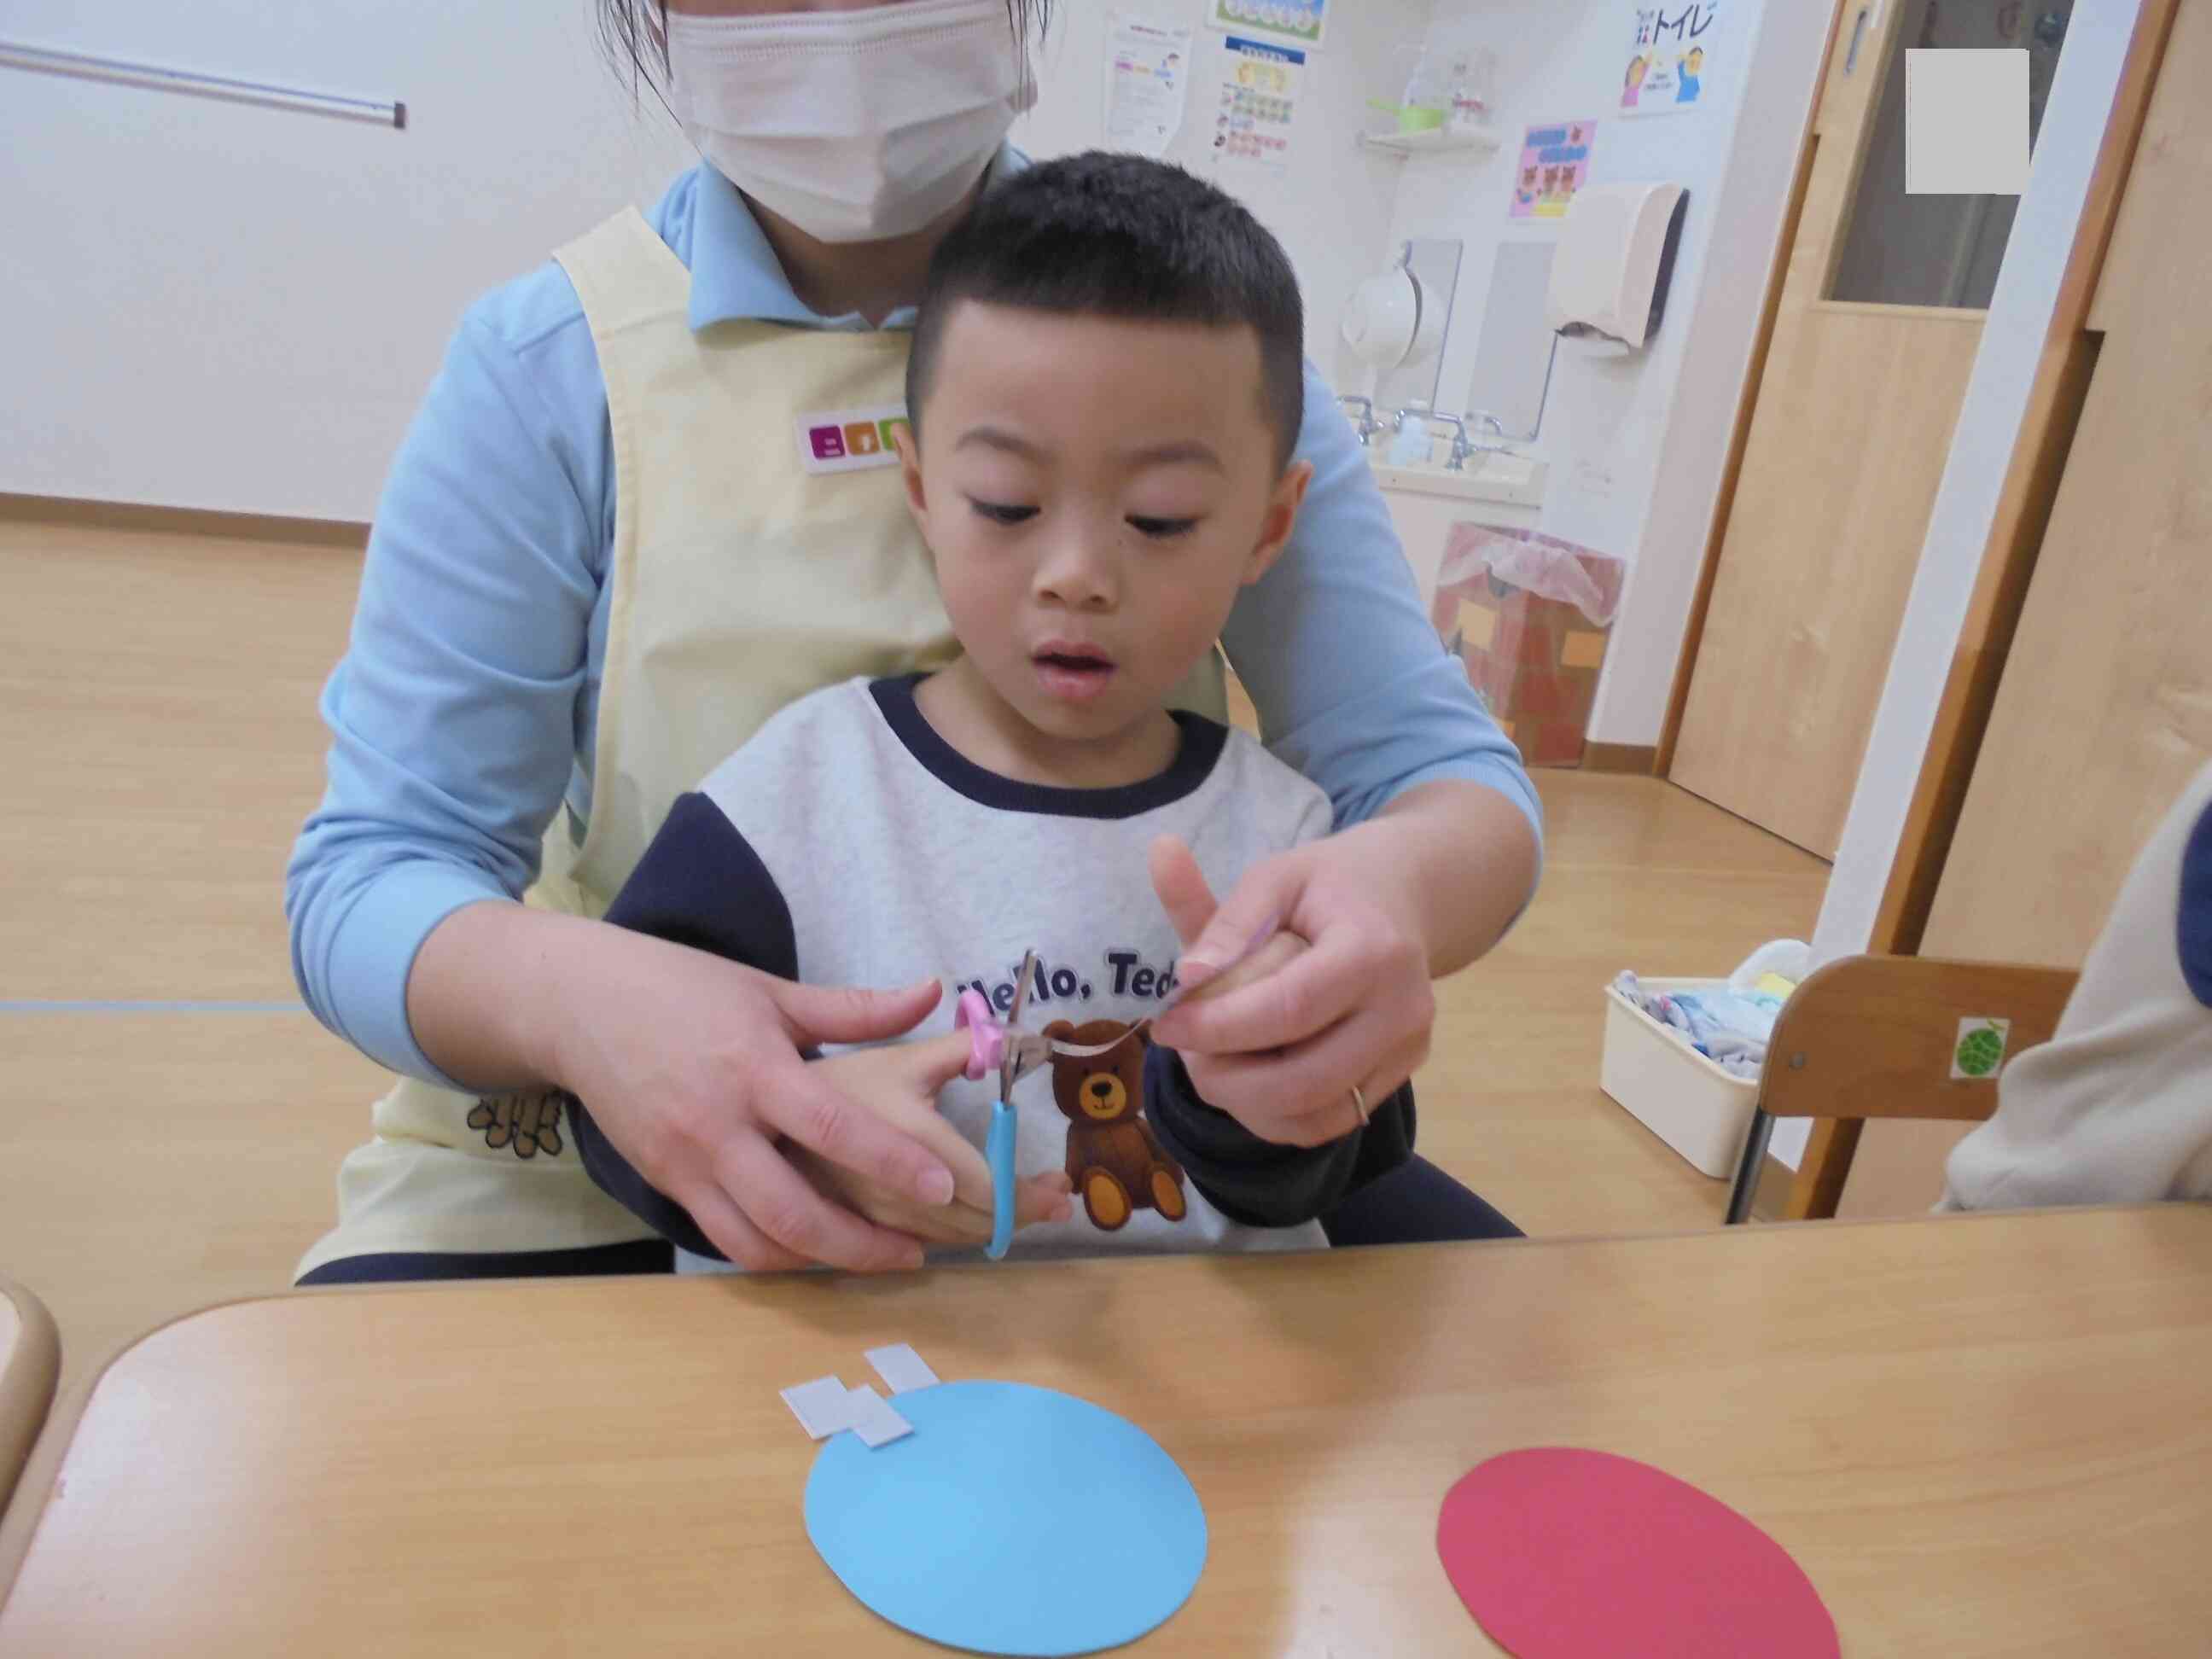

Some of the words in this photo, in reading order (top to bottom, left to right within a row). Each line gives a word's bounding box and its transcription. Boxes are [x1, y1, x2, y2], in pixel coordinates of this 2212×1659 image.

[1653, 3, 1714, 44] トイレ
[957, 957, 1091, 1016] elo,
[1109, 952, 1180, 999] Ted
